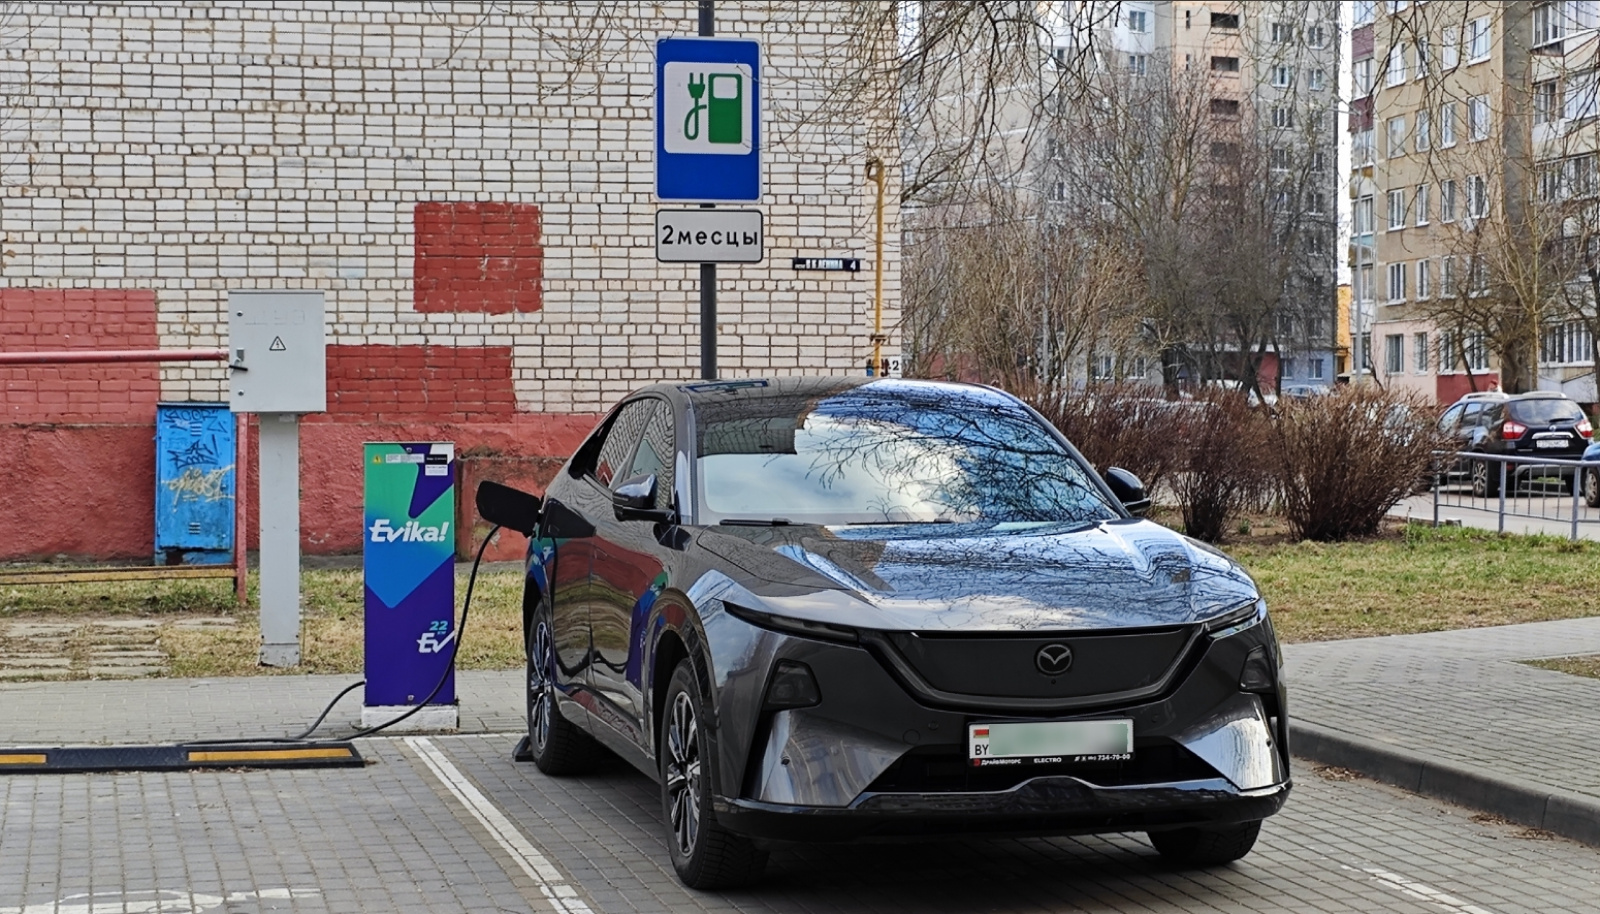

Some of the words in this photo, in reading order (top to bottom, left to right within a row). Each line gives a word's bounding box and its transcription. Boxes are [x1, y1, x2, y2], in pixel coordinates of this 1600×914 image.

[368, 519, 449, 543] Evika!
[429, 620, 449, 631] 22
[974, 744, 989, 756] BY
